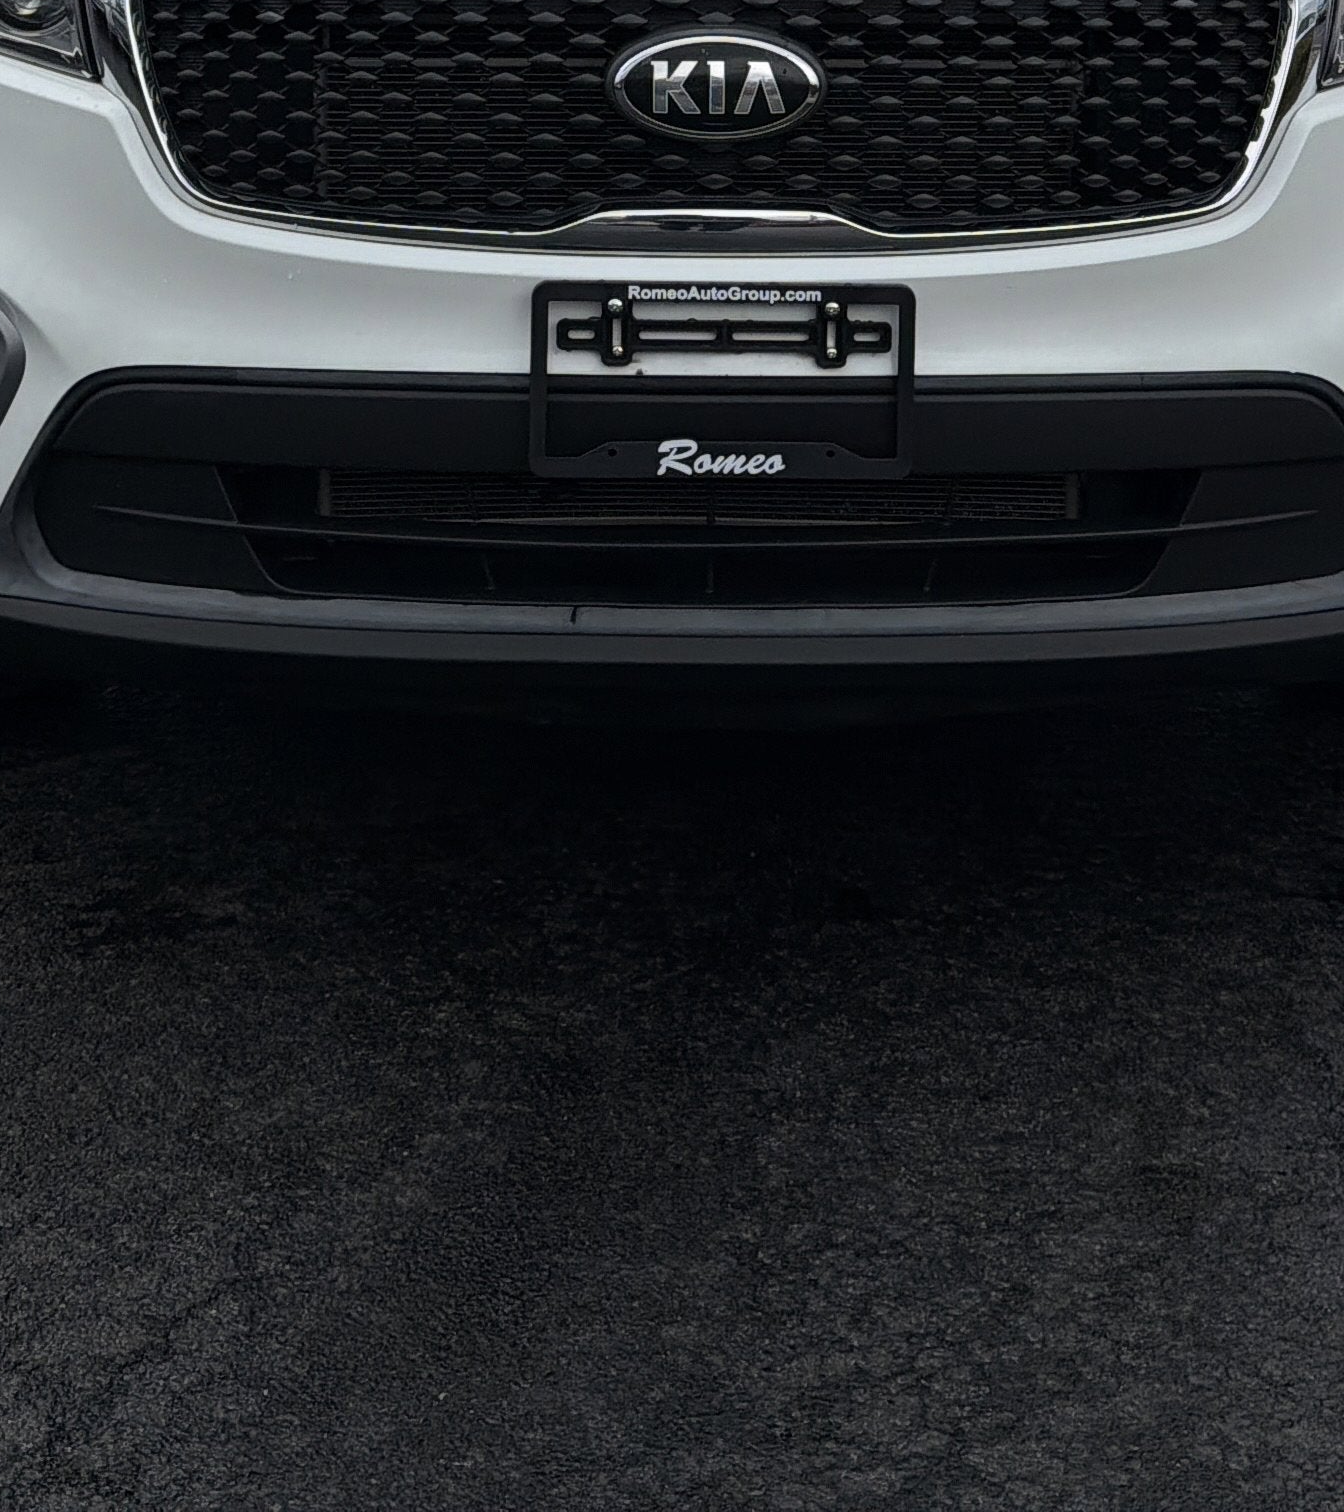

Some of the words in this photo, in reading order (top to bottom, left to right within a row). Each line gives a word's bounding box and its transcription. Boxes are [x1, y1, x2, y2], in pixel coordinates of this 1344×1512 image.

[650, 59, 786, 115] KIA
[627, 285, 822, 304] RomeoAutoGroup.com
[656, 438, 786, 476] Romeo
